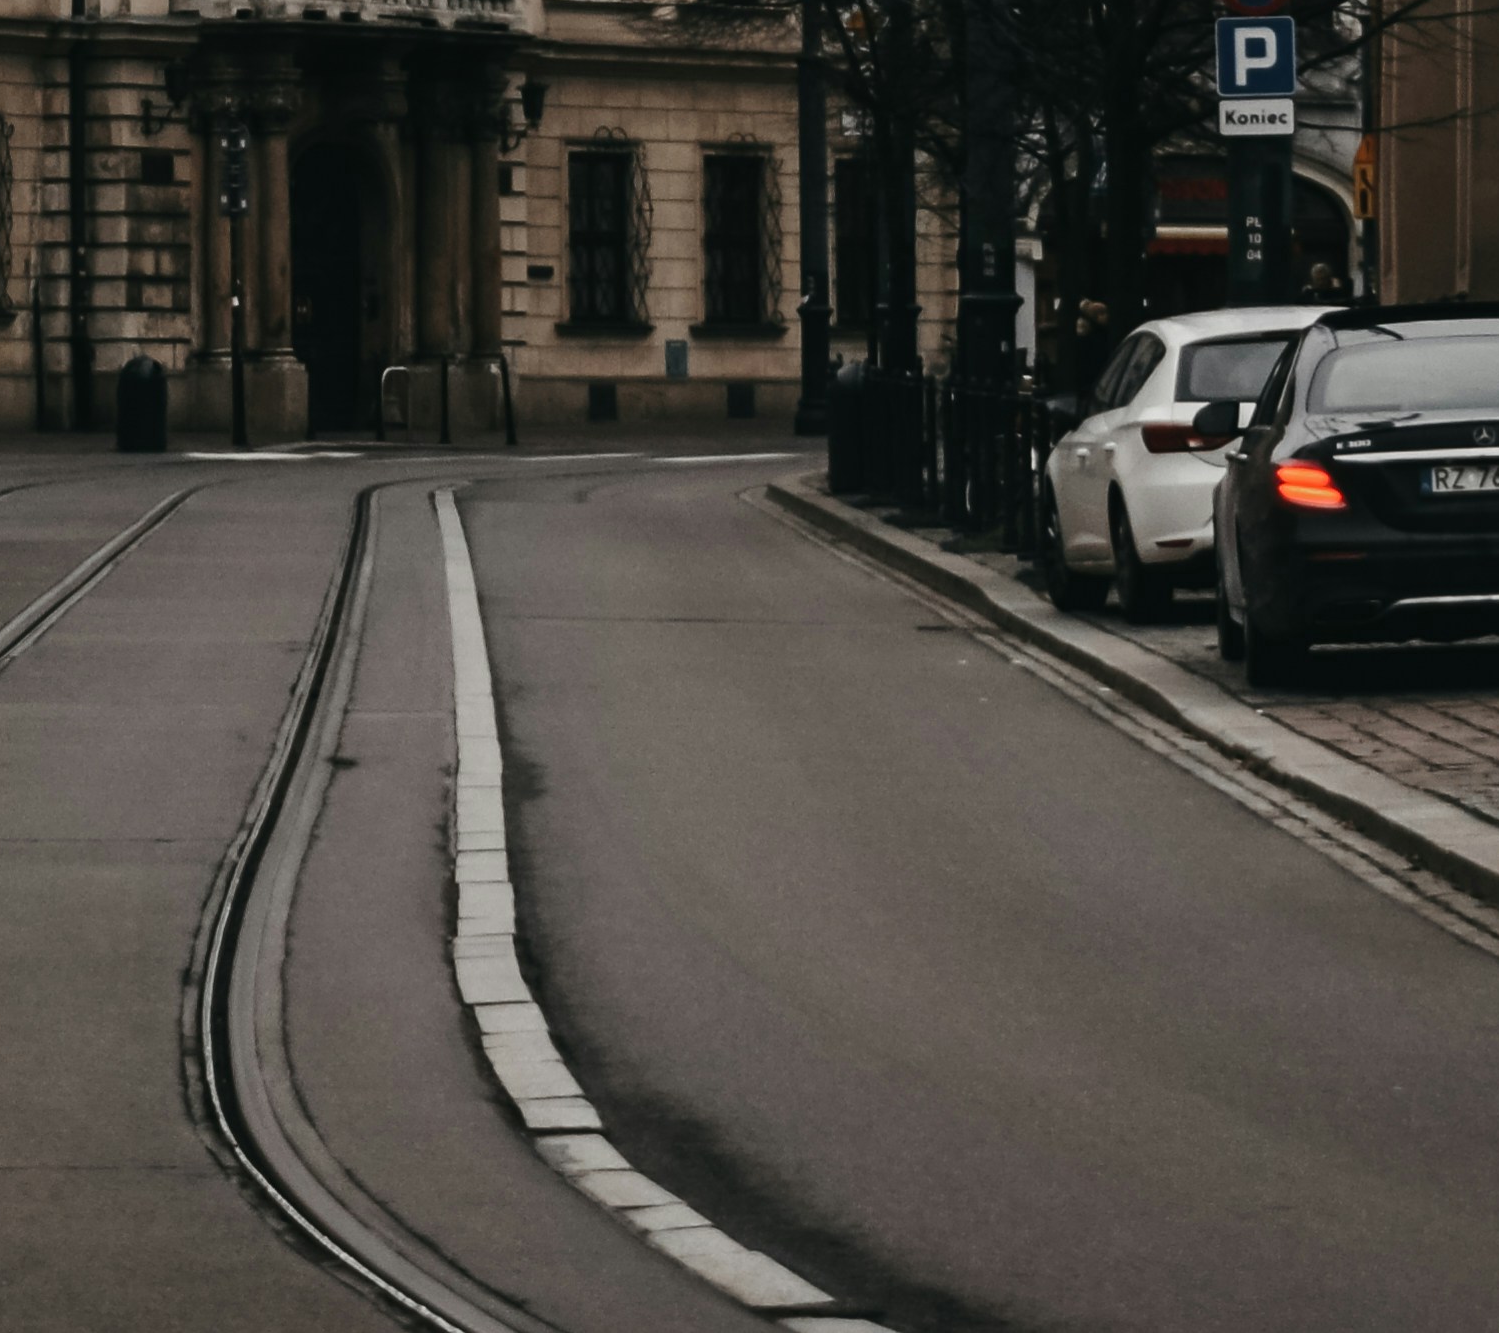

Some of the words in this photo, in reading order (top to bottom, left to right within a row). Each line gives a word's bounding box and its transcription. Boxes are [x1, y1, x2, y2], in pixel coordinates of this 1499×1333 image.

[1234, 27, 1277, 86] P
[1225, 110, 1288, 125] Koniec
[1248, 233, 1262, 244] 10
[1246, 249, 1262, 260] 04
[1435, 467, 1465, 490] RZ
